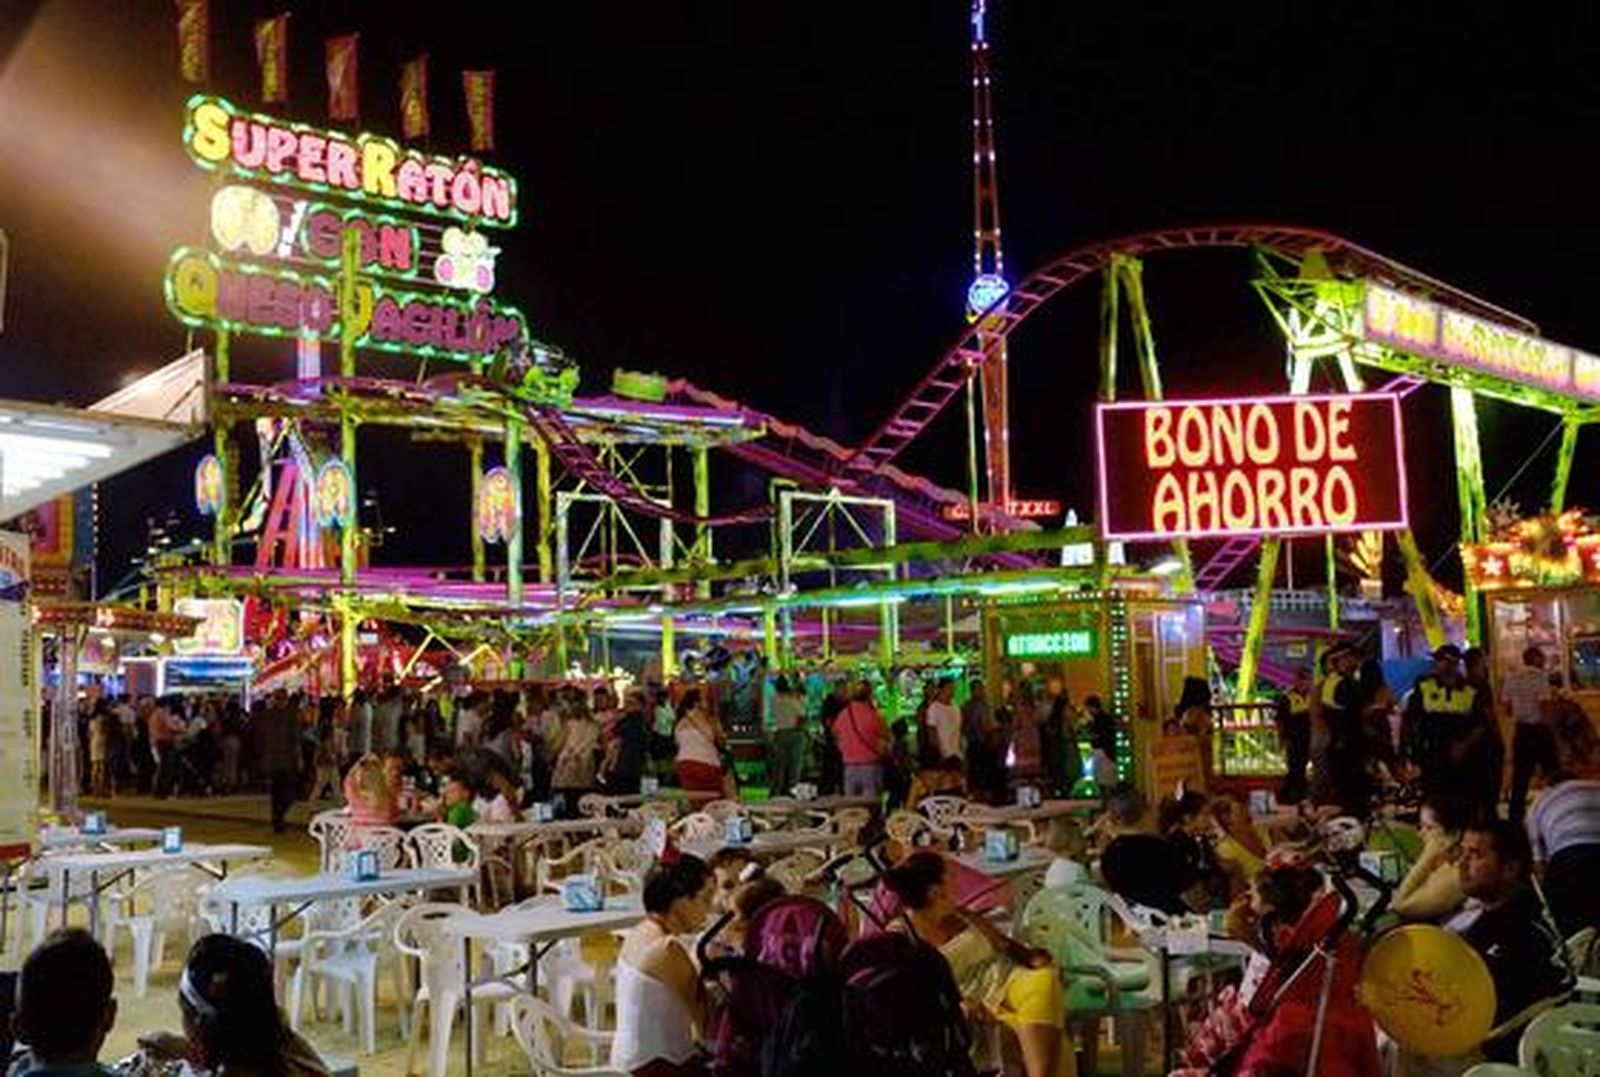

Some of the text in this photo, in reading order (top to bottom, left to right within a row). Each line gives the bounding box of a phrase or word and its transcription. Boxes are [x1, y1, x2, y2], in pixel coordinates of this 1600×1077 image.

[1145, 396, 1357, 468] BONO DE
[1153, 464, 1356, 532] AHORRO
